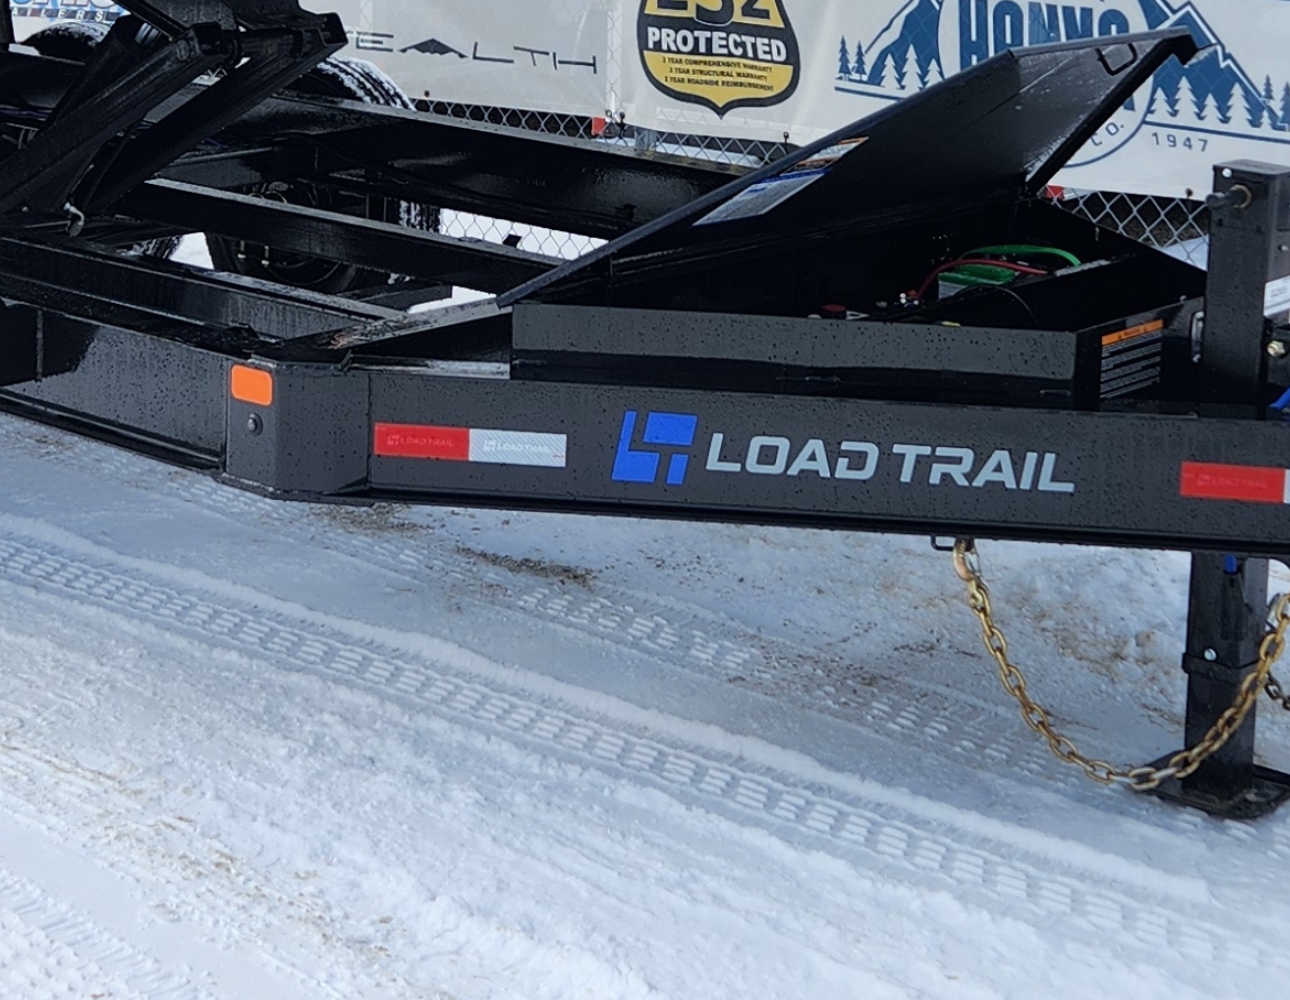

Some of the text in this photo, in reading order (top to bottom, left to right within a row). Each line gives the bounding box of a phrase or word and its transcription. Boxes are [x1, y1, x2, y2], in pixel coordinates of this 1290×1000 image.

[646, 25, 787, 63] PROTECTED
[667, 57, 684, 65] YEAR
[684, 58, 742, 69] COMPREHENSIVE
[742, 63, 773, 73] WARRANTY
[674, 67, 691, 75] YEAR
[692, 68, 735, 78] STRUCTURAL
[669, 76, 686, 84] YEAR
[687, 77, 720, 87] ROADSIDE
[1151, 131, 1209, 153] 1947
[705, 432, 1076, 494] LOAD TRAIL
